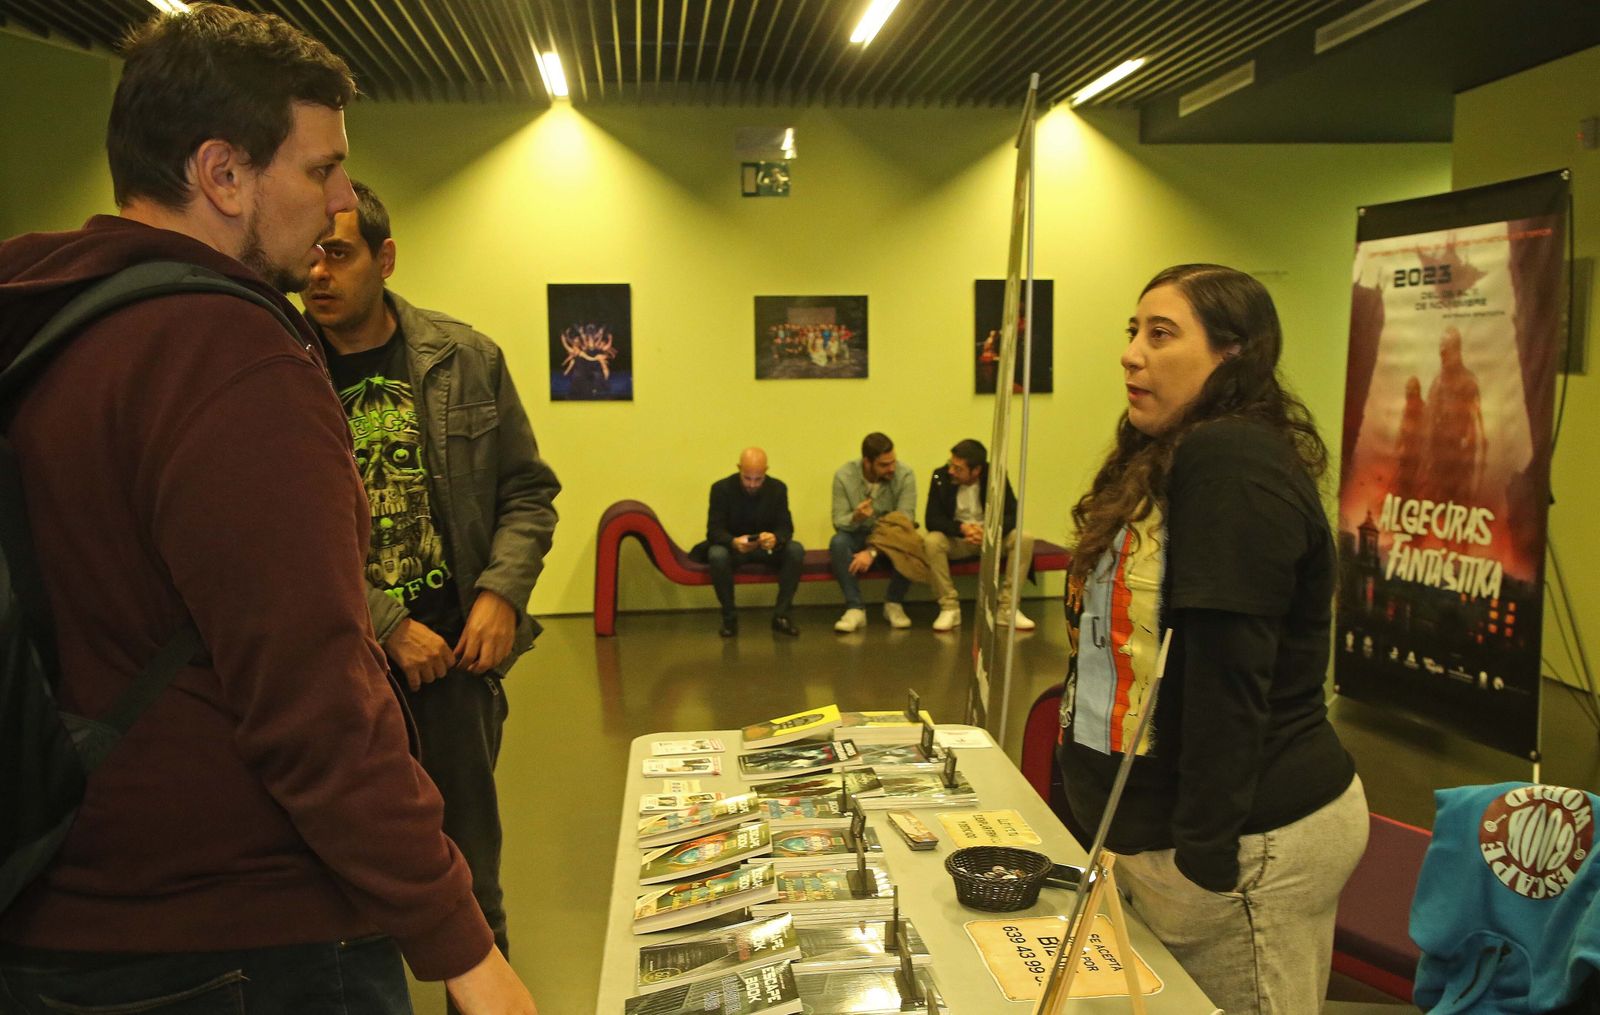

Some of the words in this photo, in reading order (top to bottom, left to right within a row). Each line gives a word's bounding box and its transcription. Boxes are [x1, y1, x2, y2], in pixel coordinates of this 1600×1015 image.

[1394, 264, 1452, 288] 2023
[1379, 492, 1496, 546] ALGECIRAS
[1504, 784, 1592, 834] WORLD
[1480, 841, 1576, 898] ESCAPE
[1002, 926, 1026, 944] 639
[1016, 945, 1037, 959] 43
[1081, 956, 1099, 972] POR
[1096, 944, 1124, 972] ACEPTA
[1024, 960, 1046, 974] 99
[744, 976, 762, 1004] BOOK
[761, 966, 782, 1004] ESCAPE
